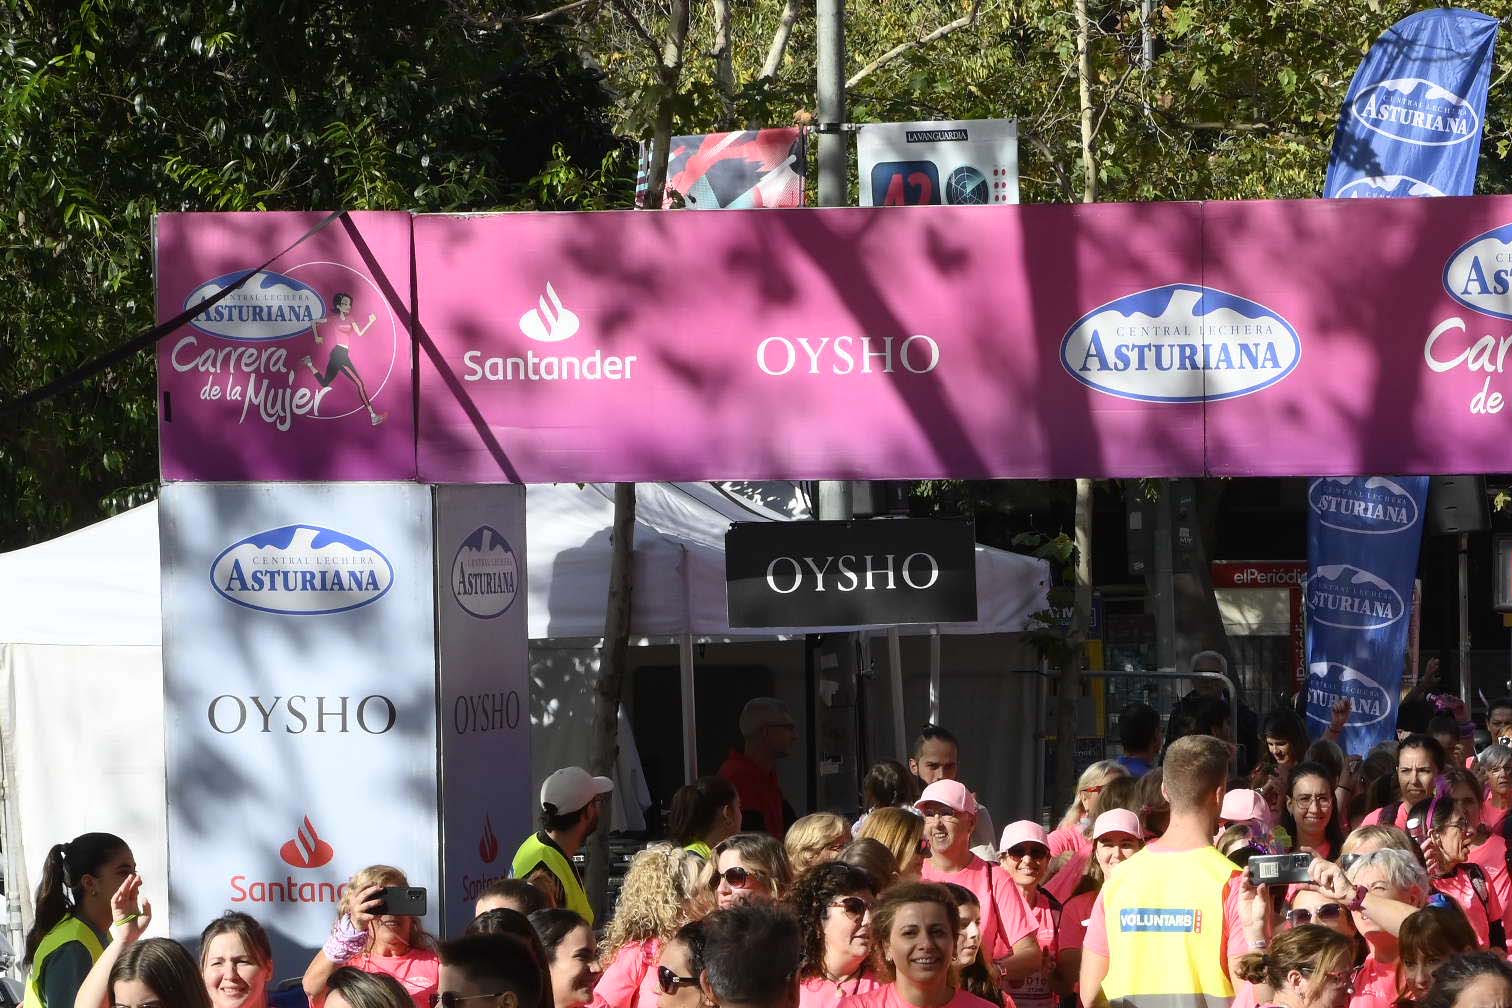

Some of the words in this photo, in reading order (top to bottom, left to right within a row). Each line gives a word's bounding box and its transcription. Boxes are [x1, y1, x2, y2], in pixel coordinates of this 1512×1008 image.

[1361, 94, 1468, 135] ASTURIANA
[1079, 329, 1282, 372] ASTURIANA
[1116, 325, 1192, 337] CENTRAL
[1199, 324, 1274, 337] LECHERA
[171, 336, 287, 374] Carrera
[464, 349, 636, 381] Santander
[756, 334, 941, 376] OYSHO
[200, 375, 221, 401] de
[226, 375, 242, 401] la
[239, 371, 333, 432] Mujer
[1470, 375, 1504, 415] de
[224, 558, 381, 592] ASTURIANA
[252, 556, 313, 566] CENTRAL
[457, 560, 515, 596] ASTURIANA
[766, 552, 940, 595] OYSHO
[207, 694, 398, 735] OYSHO
[453, 690, 521, 735] OYSHO
